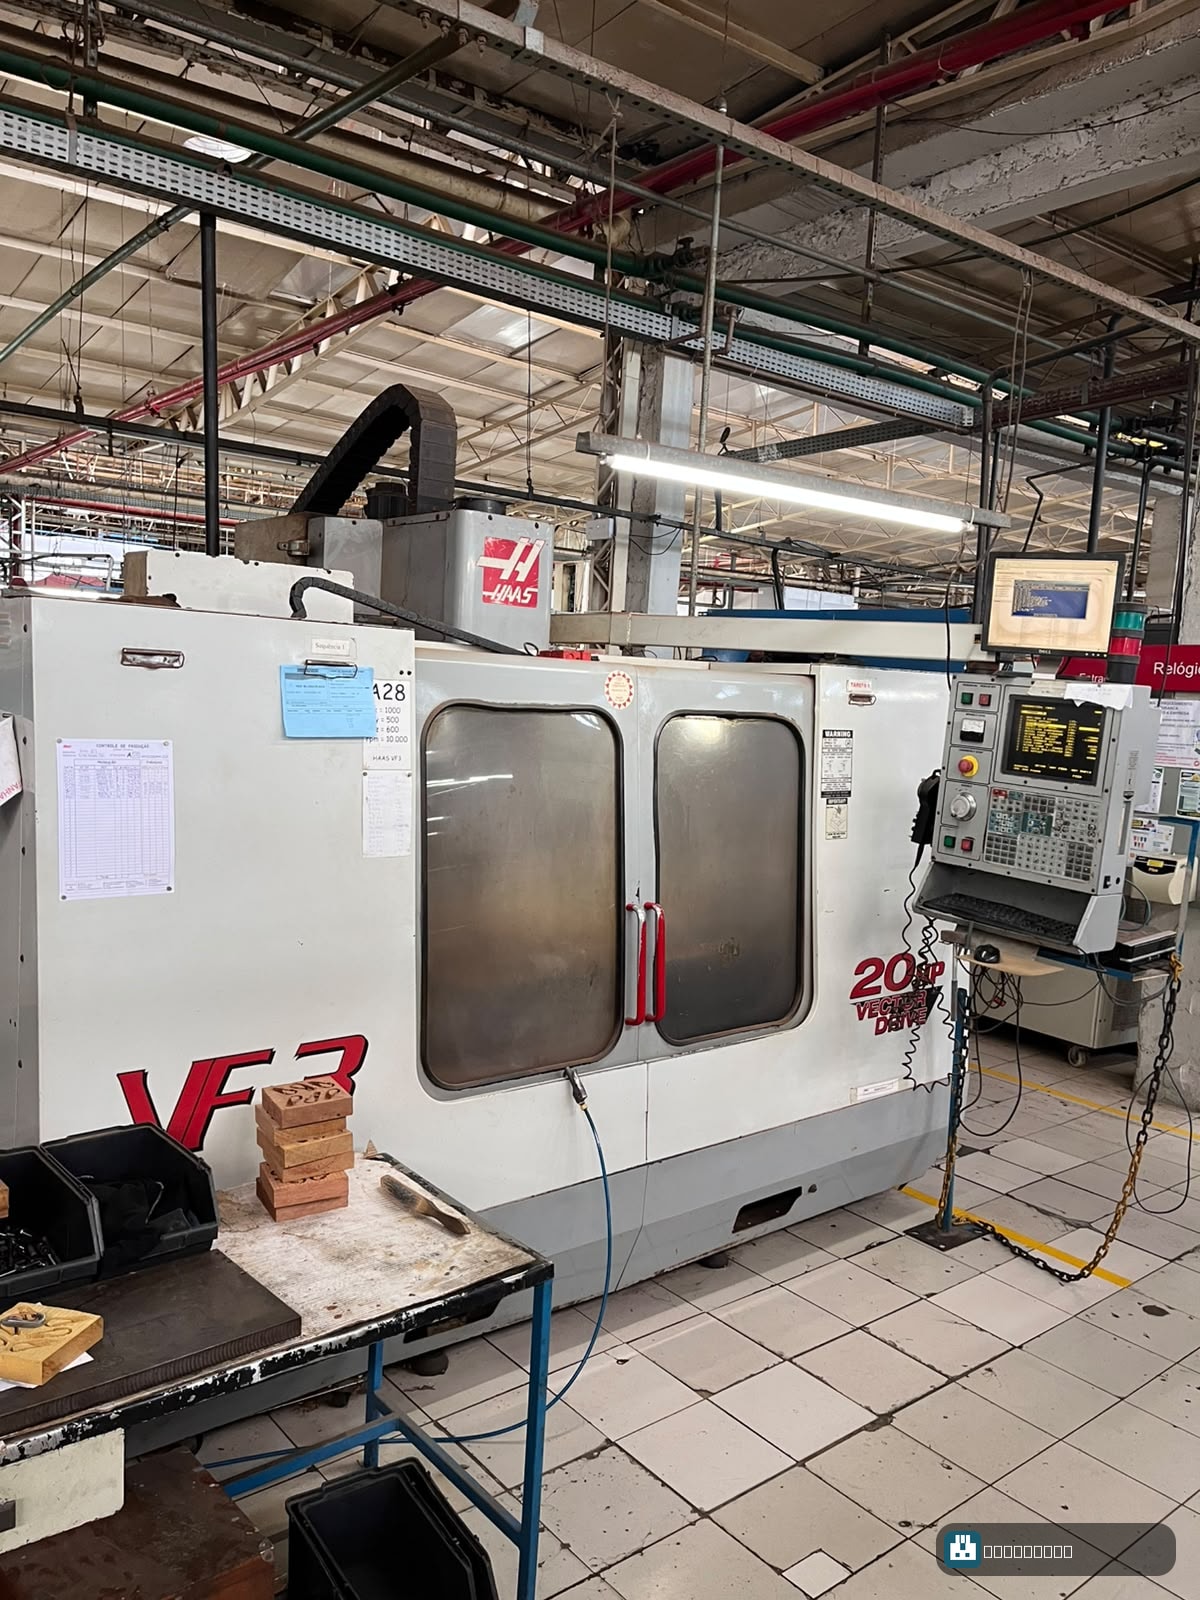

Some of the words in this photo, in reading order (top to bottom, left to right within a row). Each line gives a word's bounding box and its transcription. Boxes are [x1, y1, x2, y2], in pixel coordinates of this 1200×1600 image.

[482, 584, 538, 603] HAAS
[1153, 661, 1200, 679] Relógi
[373, 683, 406, 701] A28
[385, 706, 401, 714] 1000
[386, 716, 400, 724] 500
[824, 730, 851, 738] WARNING
[849, 952, 916, 999] 20
[856, 990, 927, 1020] VECTOR
[875, 1007, 928, 1035] DRIVE
